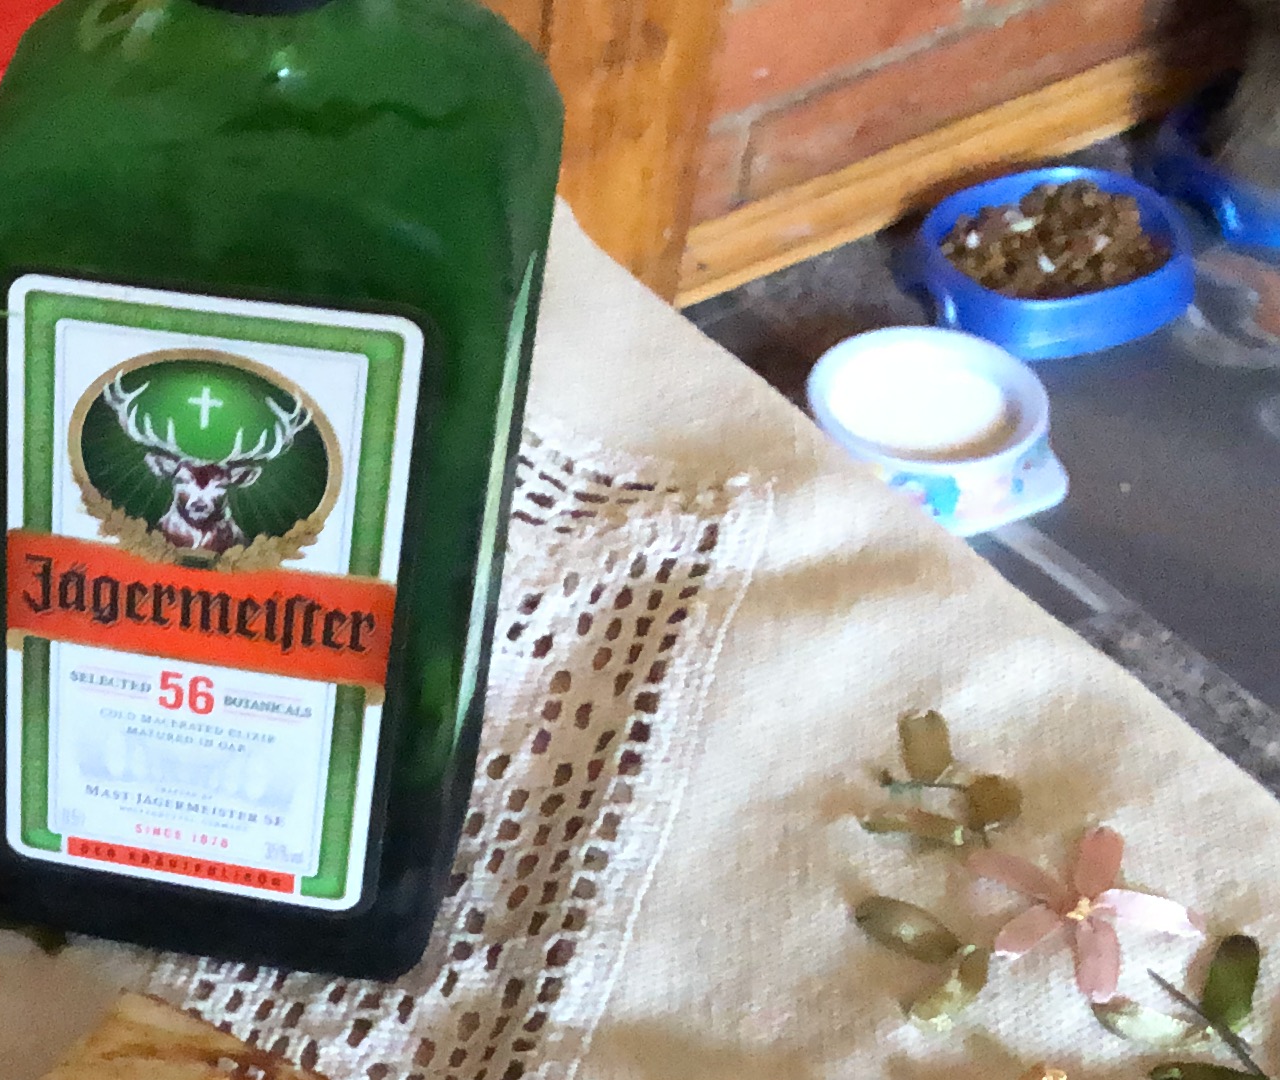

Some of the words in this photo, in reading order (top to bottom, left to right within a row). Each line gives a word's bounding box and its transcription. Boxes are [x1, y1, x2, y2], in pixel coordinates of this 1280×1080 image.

[69, 669, 153, 693] SELECTED
[157, 670, 215, 715] 56
[224, 695, 312, 718] BOTANICALS
[134, 823, 182, 841] SINCE
